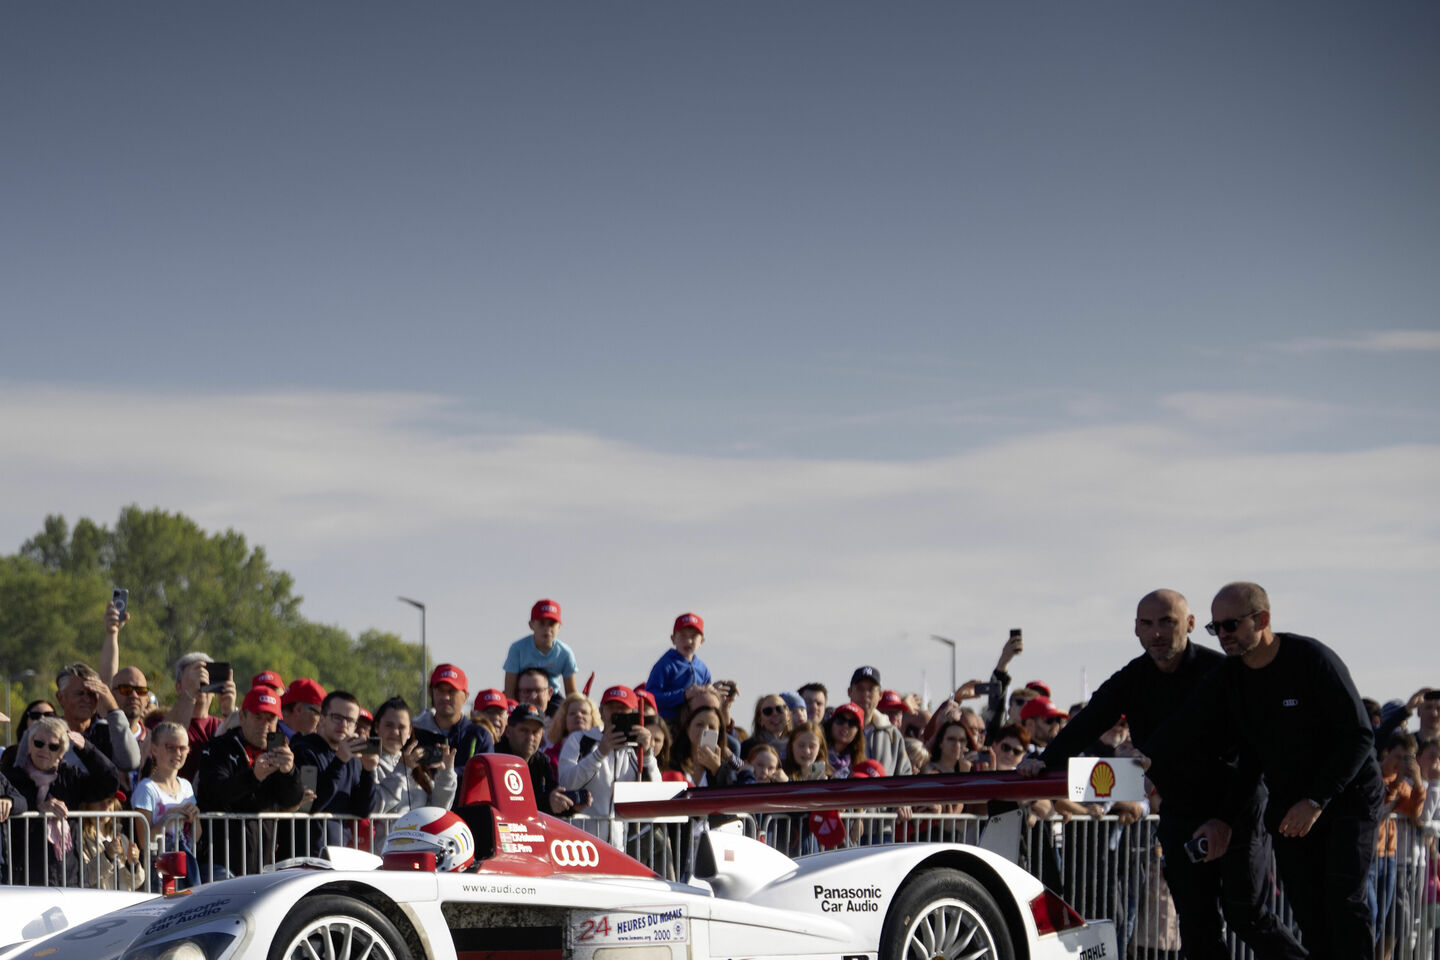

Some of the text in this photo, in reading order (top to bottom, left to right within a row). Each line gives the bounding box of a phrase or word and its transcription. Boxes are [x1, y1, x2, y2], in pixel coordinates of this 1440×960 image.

[462, 884, 537, 895] www.audi.com
[813, 884, 883, 899] Panasonic
[821, 899, 879, 912] Car Audio
[177, 906, 223, 925] Audio
[578, 908, 682, 941] 24 HEURES DU MANS
[653, 929, 671, 941] 2000
